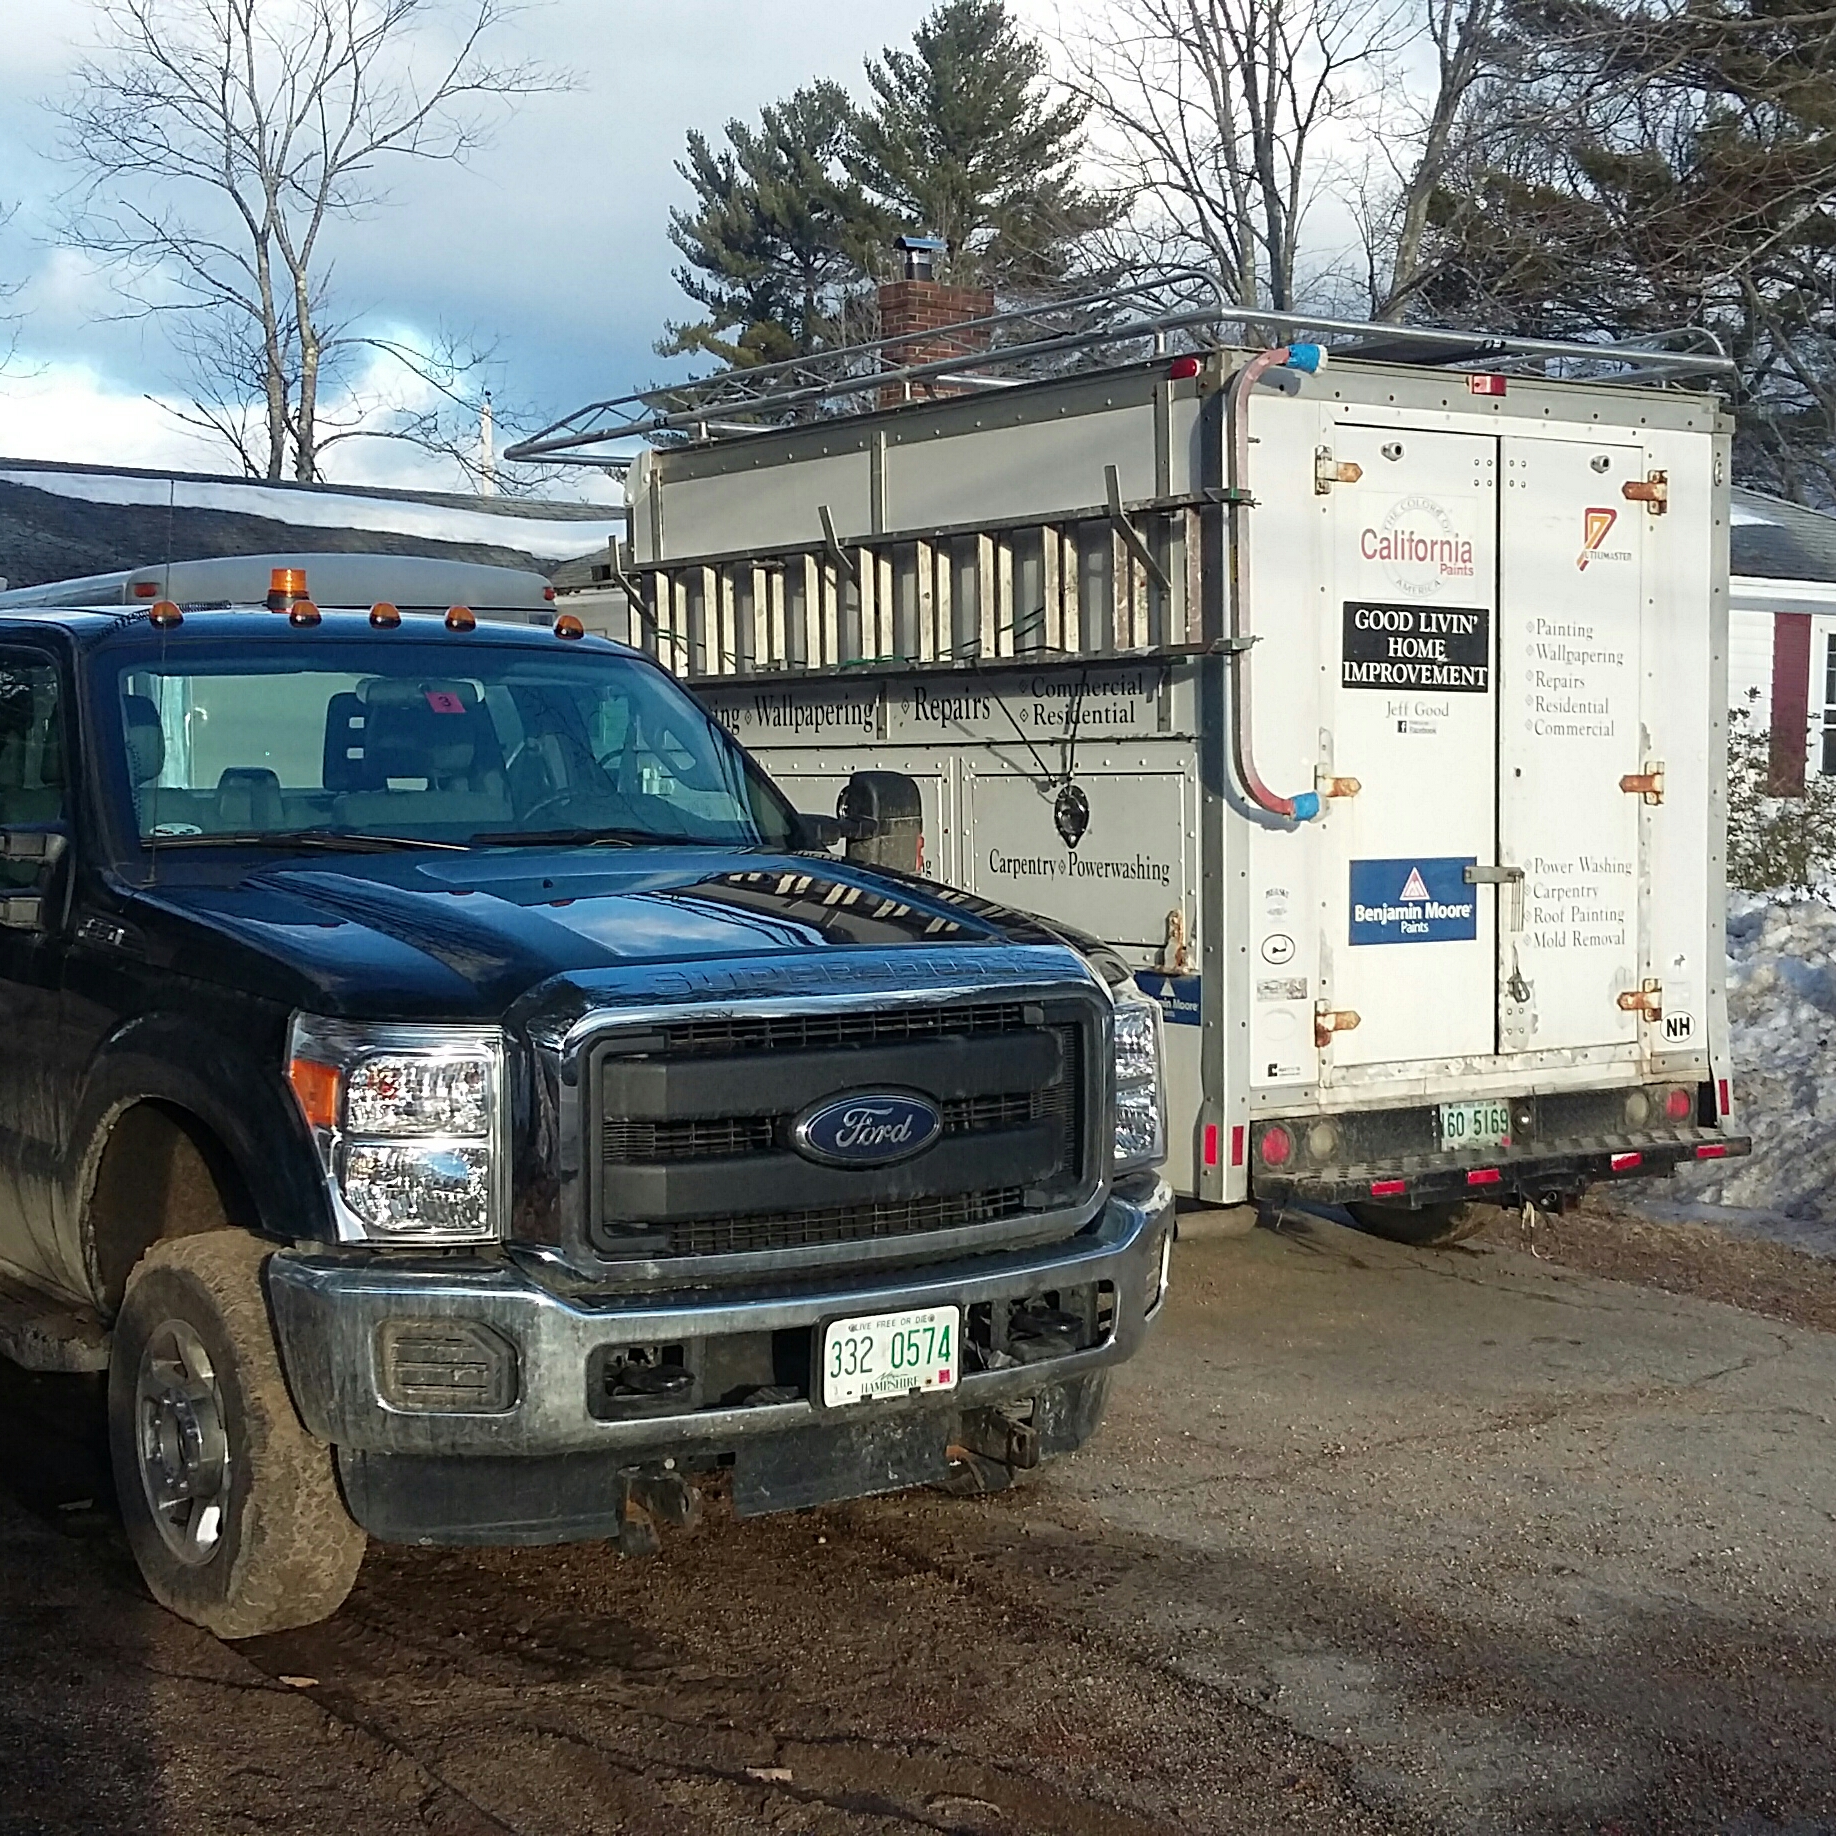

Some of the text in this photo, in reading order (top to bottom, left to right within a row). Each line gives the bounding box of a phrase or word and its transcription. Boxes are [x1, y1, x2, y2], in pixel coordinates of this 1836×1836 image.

[1361, 528, 1473, 563] California
[1440, 563, 1474, 576] Paints
[1355, 609, 1478, 634] GOOD LIVIN'
[1537, 618, 1593, 641] Painting
[1388, 637, 1447, 659] HOME
[1536, 643, 1623, 666] Wallpapering
[1343, 661, 1487, 686] IMPROVEMENT
[1536, 670, 1585, 691] Repairs
[1031, 672, 1143, 698] Commercial
[755, 694, 874, 733] Wallpapering
[914, 686, 990, 728] Repairs
[1033, 700, 1135, 726] Residential
[1386, 701, 1449, 718] Jeff Good
[1535, 695, 1609, 714] Residential
[1535, 718, 1614, 736] Commercial
[989, 849, 1170, 886] Carpentry Powerwashing
[1535, 856, 1632, 876] Power Washing
[1533, 882, 1598, 902] Carpentry
[1355, 901, 1471, 925] Benjamin Moore
[1534, 905, 1625, 924] Roof Painting
[1401, 920, 1430, 933] Paints
[1534, 927, 1625, 948] Mold Removal
[1666, 1016, 1690, 1037] NH
[836, 1107, 913, 1147] Ford
[1473, 1108, 1509, 1136] 5169
[855, 1314, 928, 1331] LIVE FREE OR DIE
[830, 1324, 951, 1379] 332 0574
[861, 1375, 919, 1393] HAMPSHIRE
